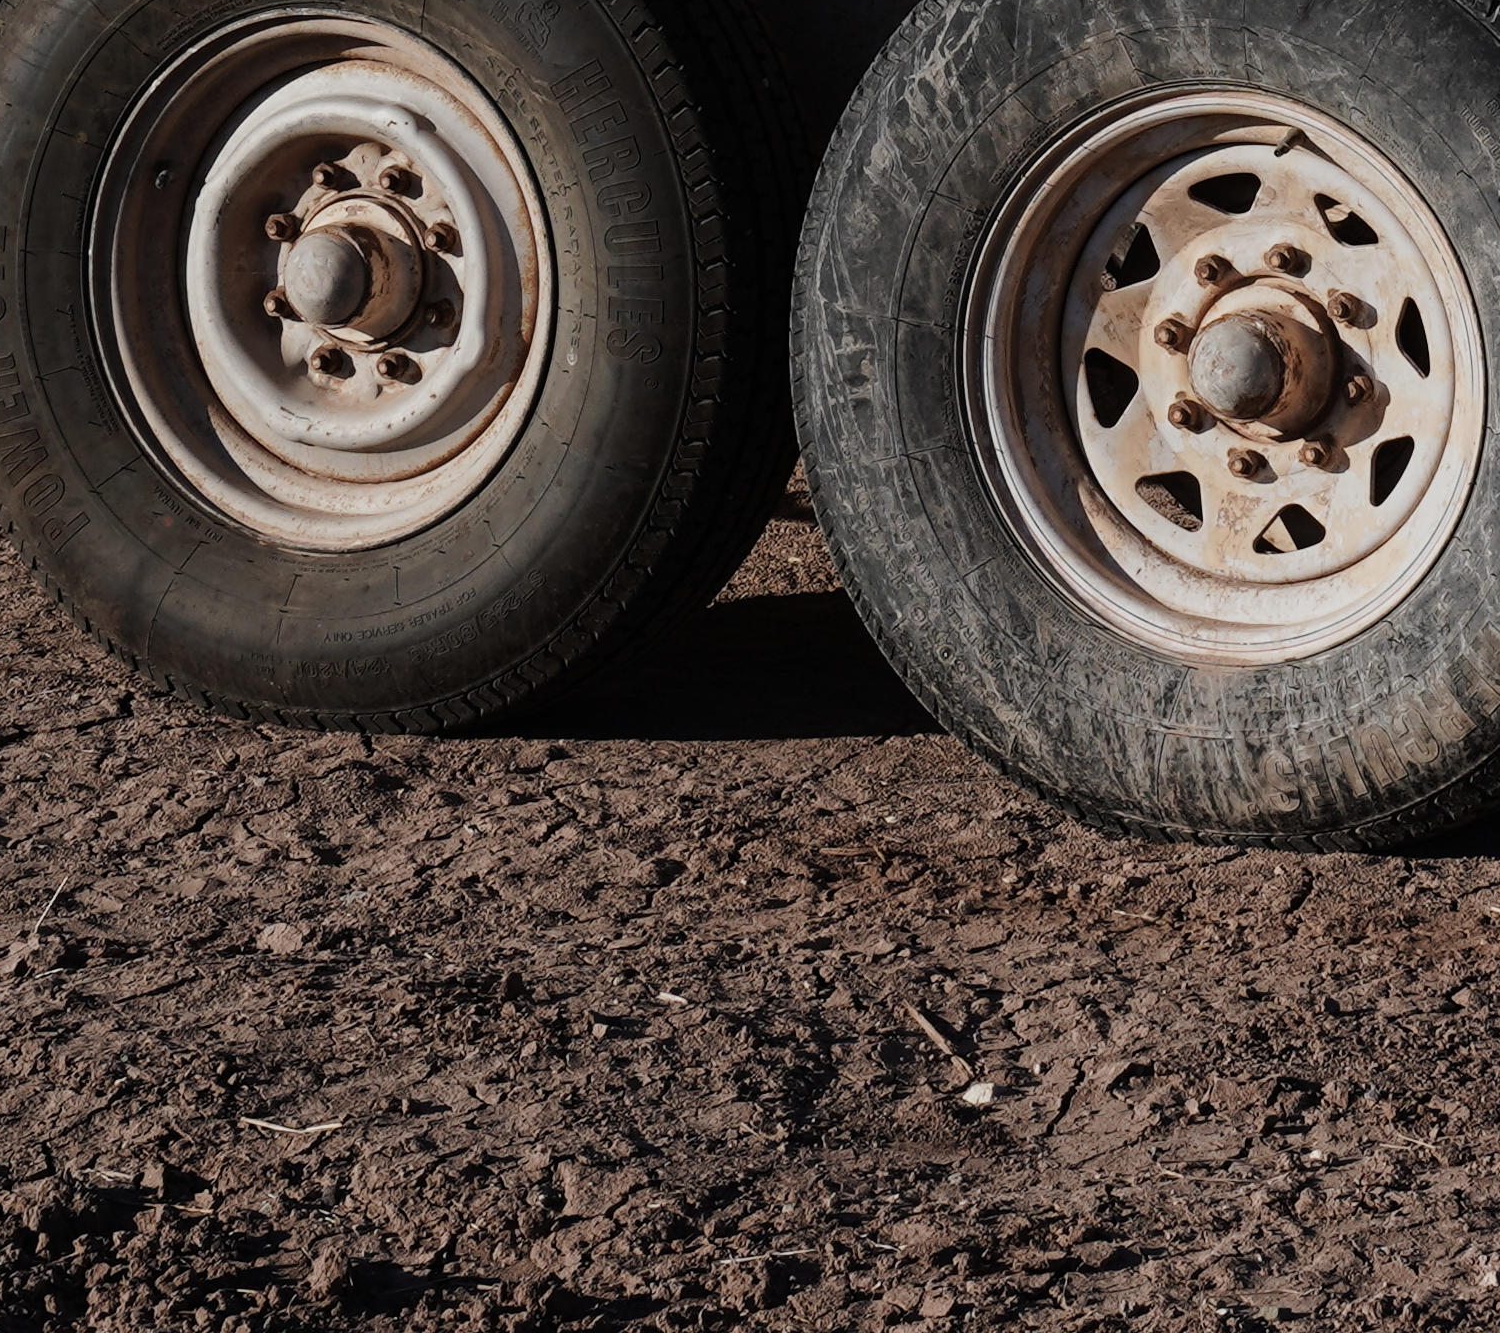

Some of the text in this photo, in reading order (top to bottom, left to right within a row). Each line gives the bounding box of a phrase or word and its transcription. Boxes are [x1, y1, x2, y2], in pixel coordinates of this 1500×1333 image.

[552, 58, 666, 366] HERCULES
[322, 584, 478, 644] FOR TRAILER SERVICE ONLY
